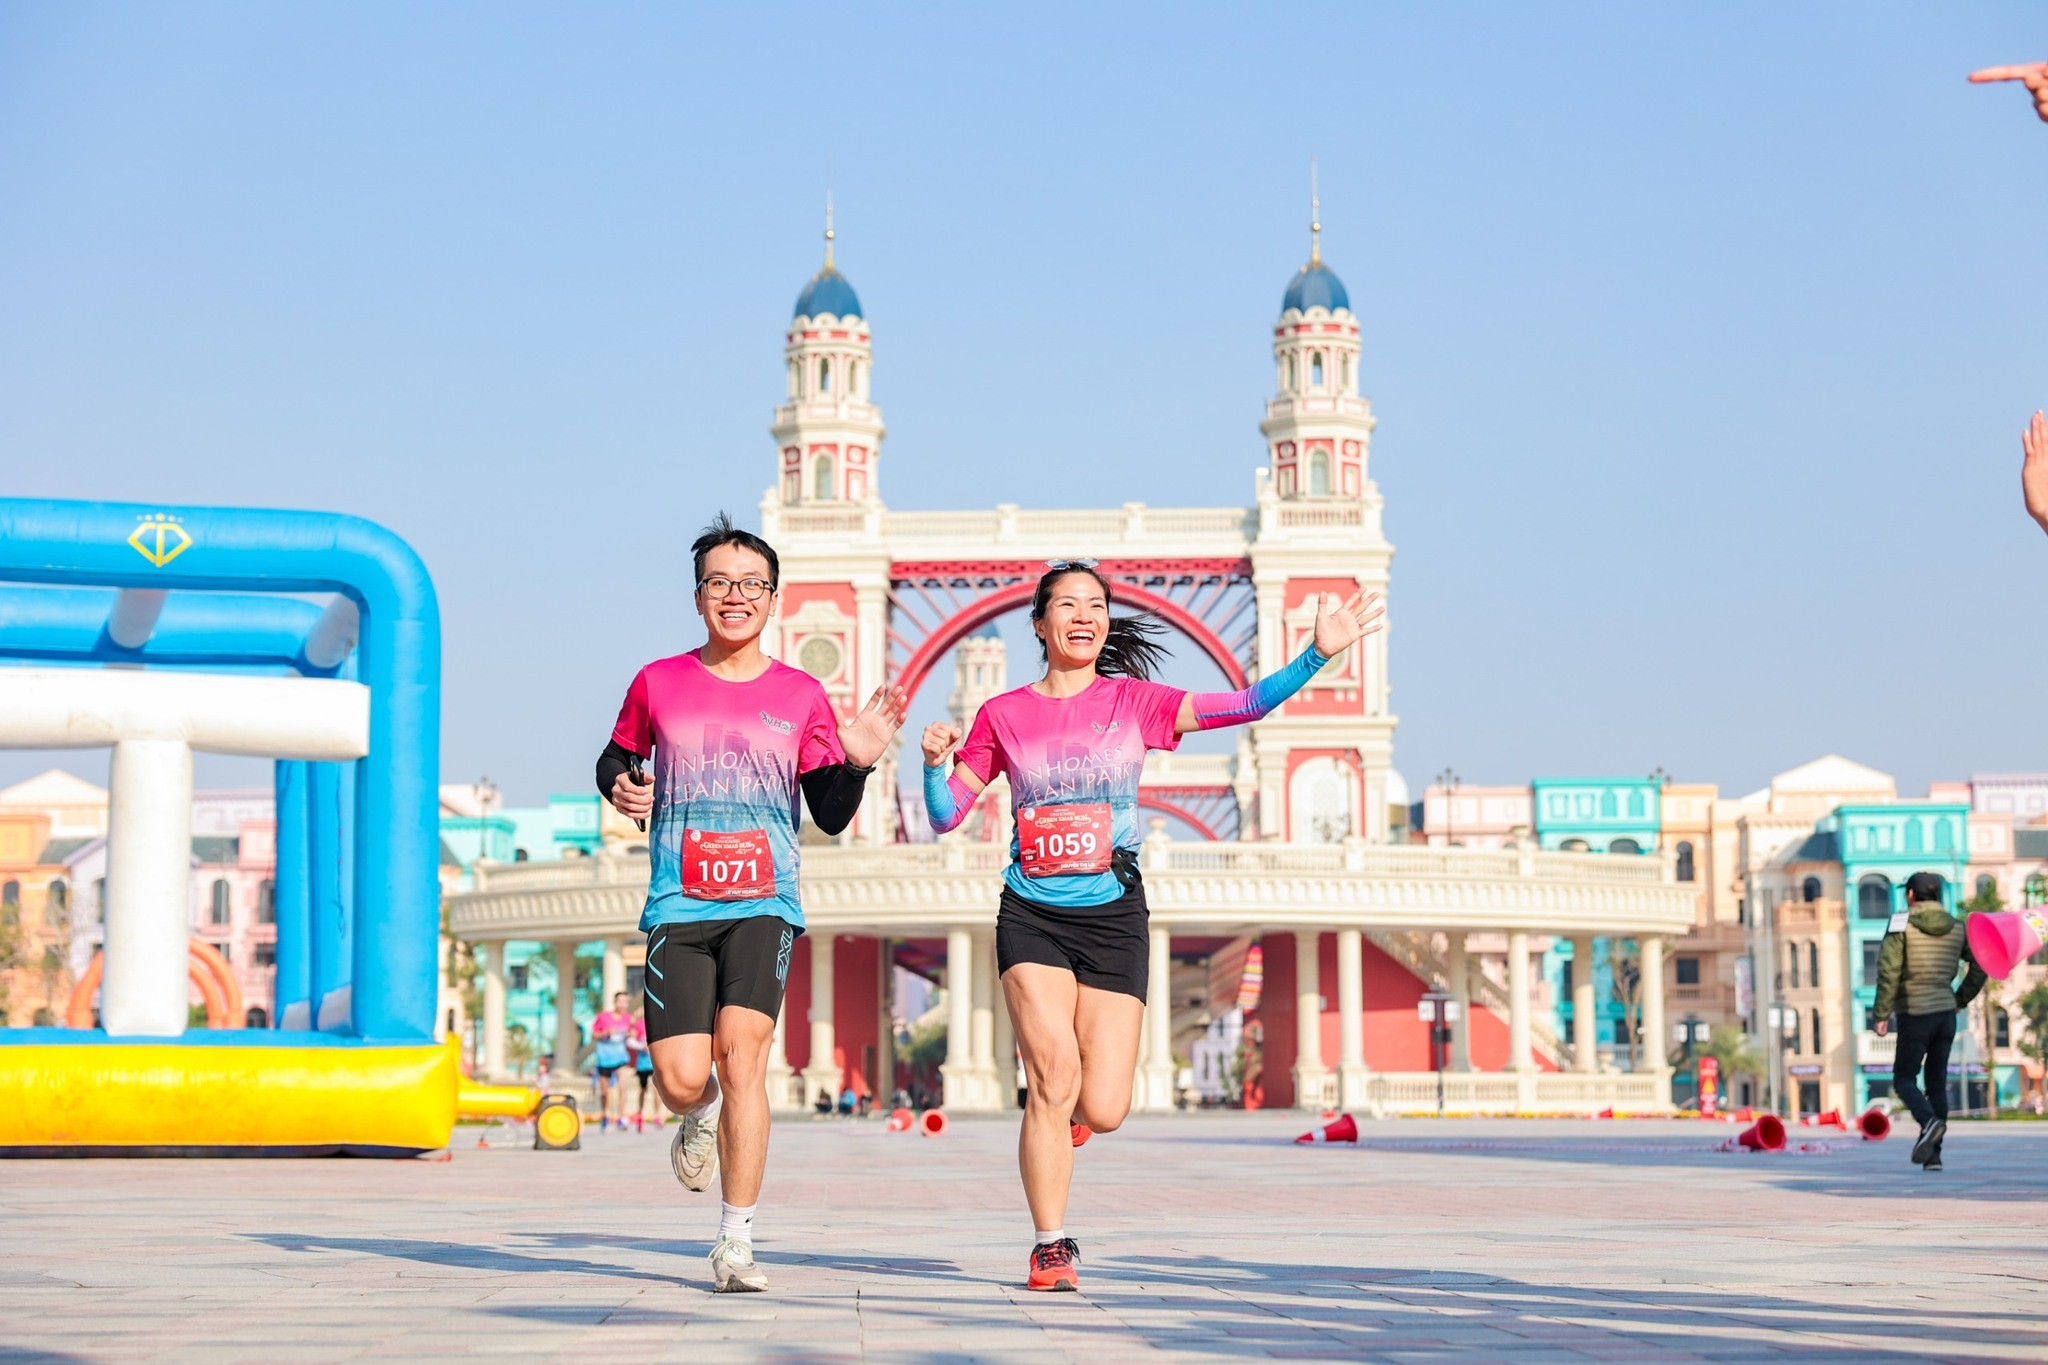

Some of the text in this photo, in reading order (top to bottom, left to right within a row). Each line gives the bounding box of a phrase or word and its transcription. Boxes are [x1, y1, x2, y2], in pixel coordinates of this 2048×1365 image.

[664, 749, 783, 781] VINHOMES
[1014, 744, 1122, 791] VINHOMES
[1086, 762, 1131, 788] PARK
[1034, 832, 1097, 858] 1059
[698, 859, 758, 883] 1071
